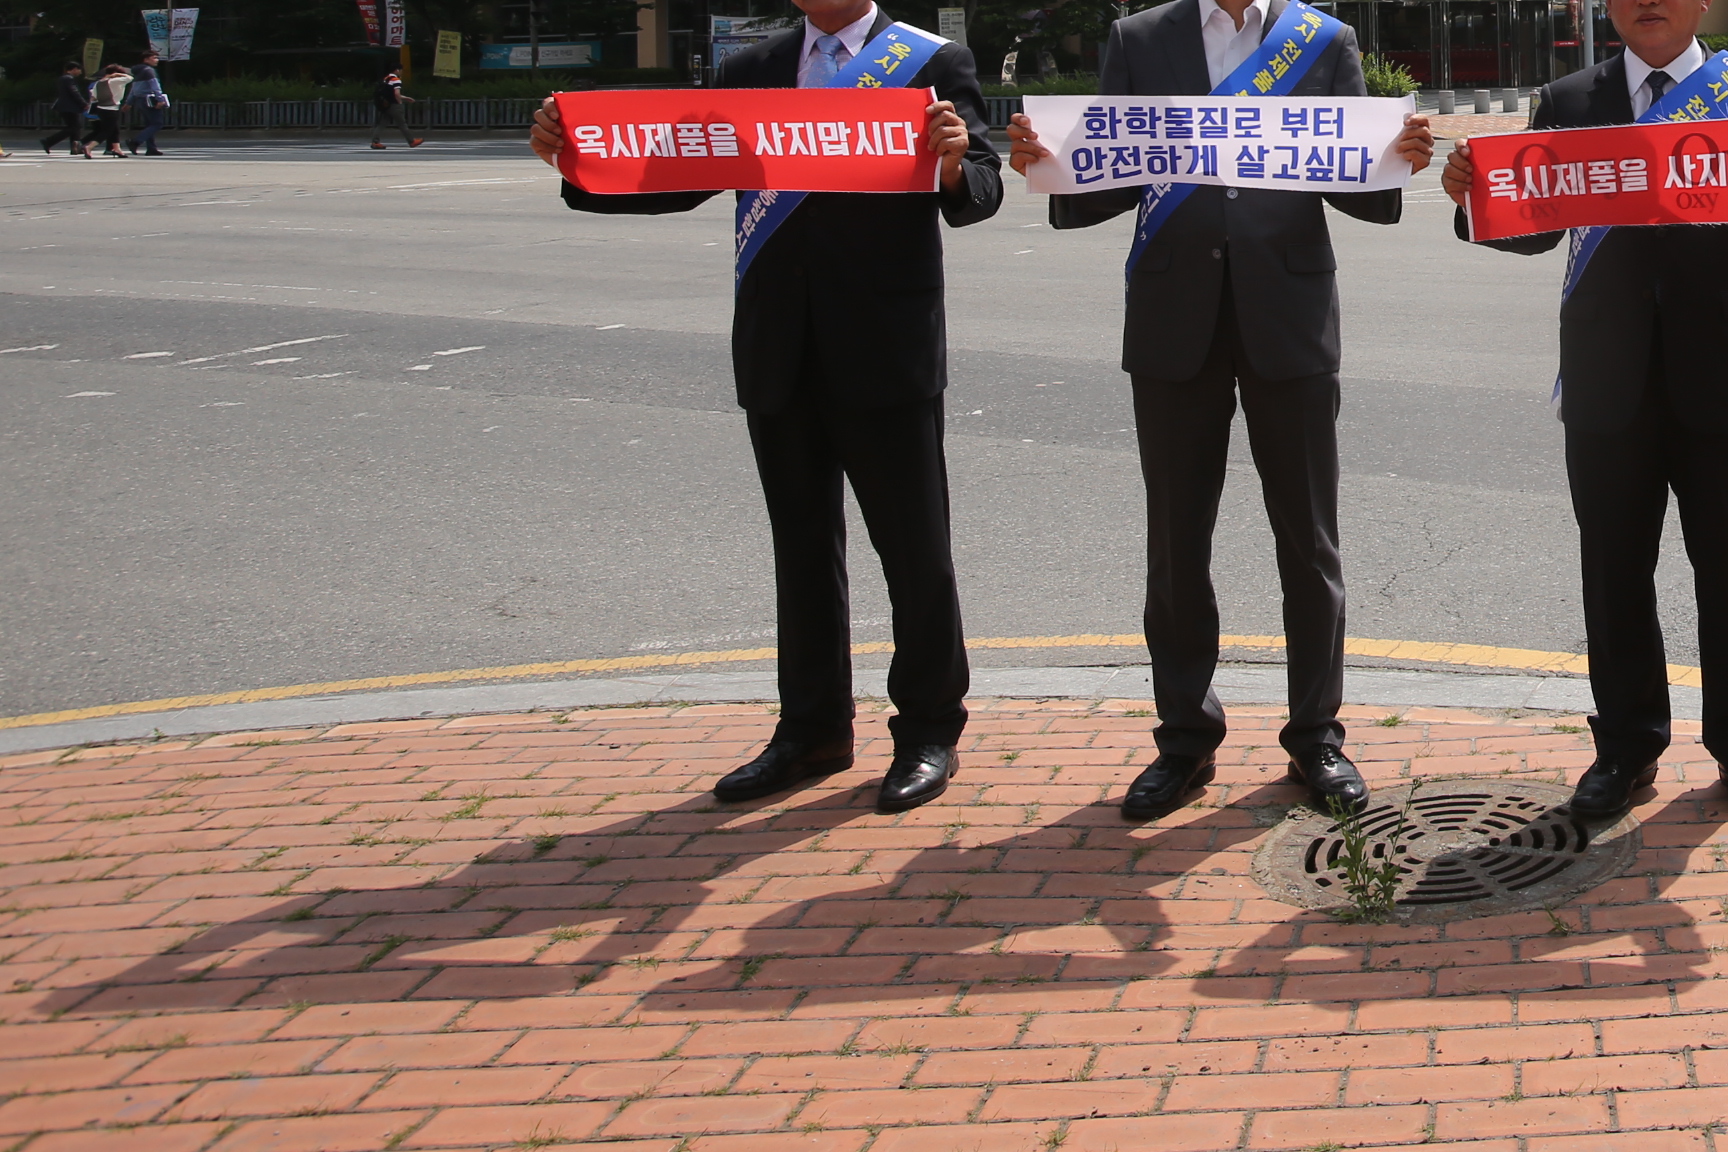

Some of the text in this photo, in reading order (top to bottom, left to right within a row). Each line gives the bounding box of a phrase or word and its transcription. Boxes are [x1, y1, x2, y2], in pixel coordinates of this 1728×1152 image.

[574, 121, 920, 159] 옥시제품을 사지맙시다
[1083, 105, 1344, 140] 화학물질로 부터
[1071, 145, 1373, 185] 안전하게 살고싶다
[1487, 158, 1649, 202] 옥시제품을
